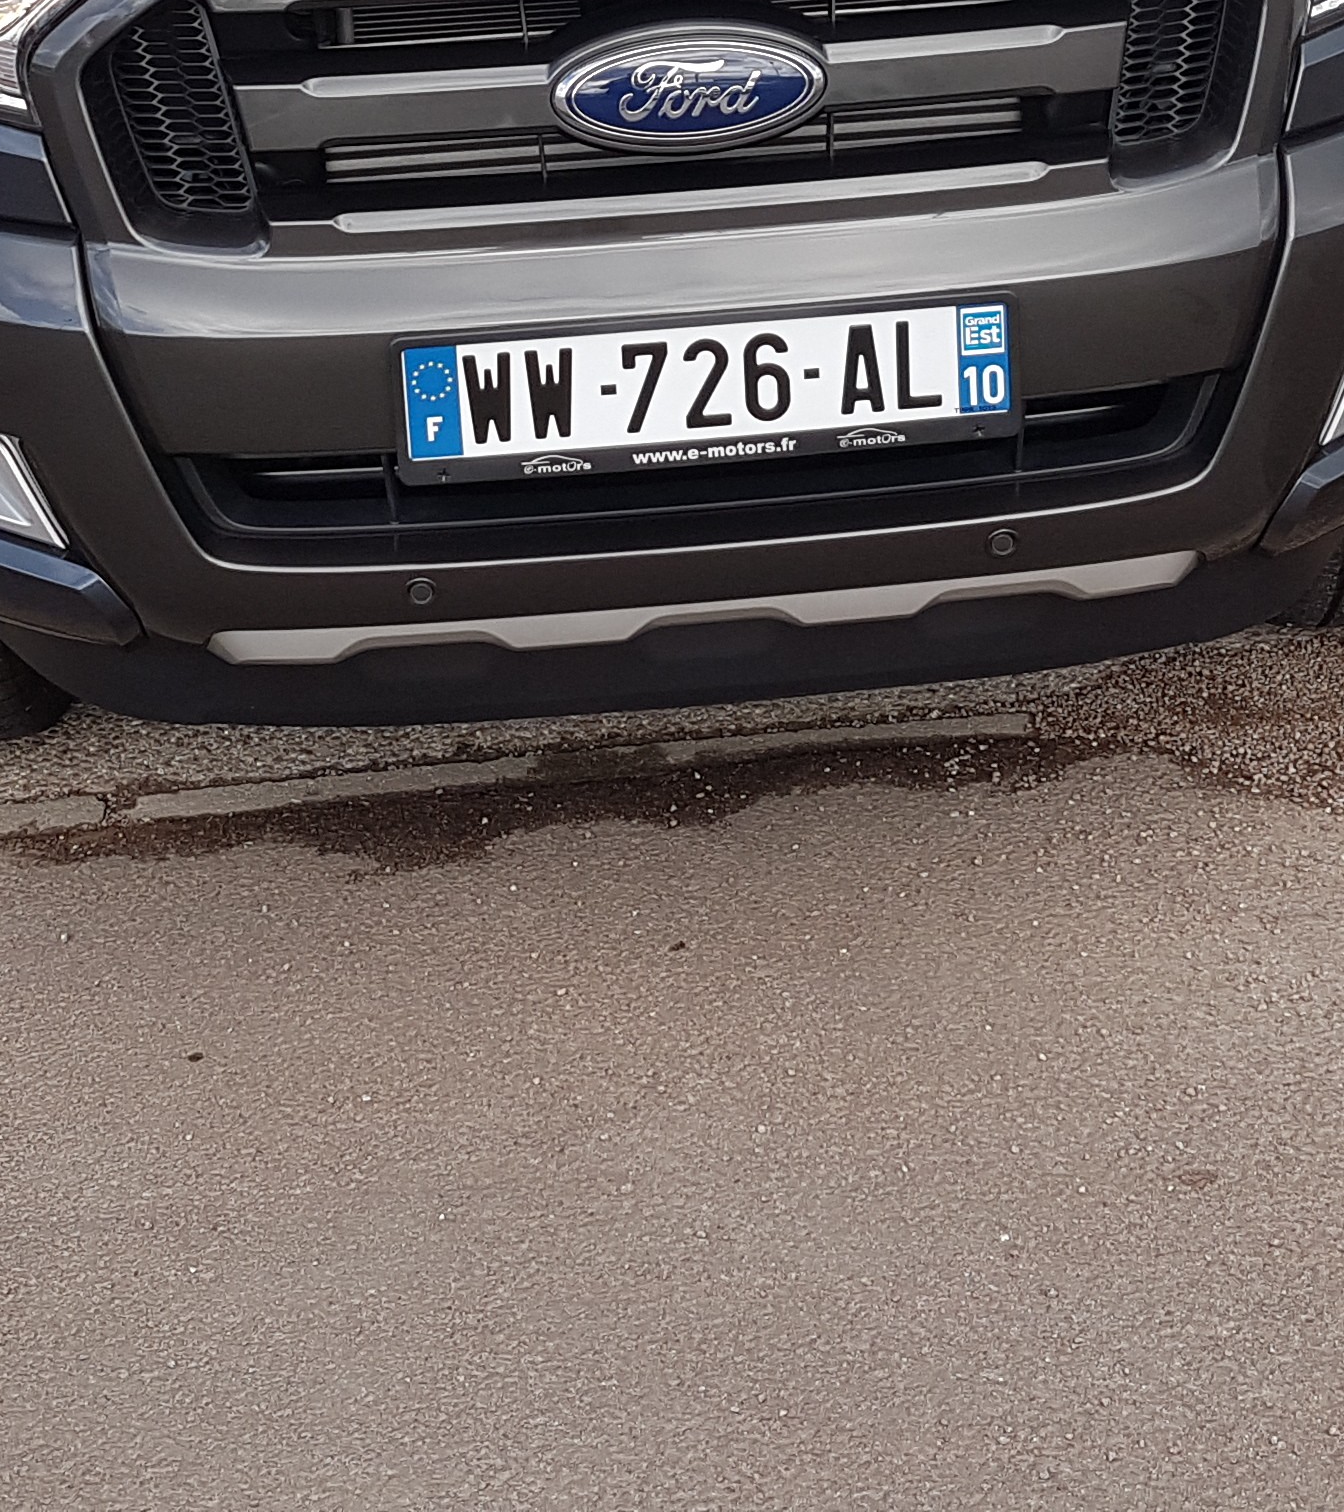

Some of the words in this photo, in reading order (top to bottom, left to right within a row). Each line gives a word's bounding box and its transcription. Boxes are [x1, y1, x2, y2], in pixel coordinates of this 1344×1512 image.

[619, 59, 762, 123] Ford
[965, 314, 1000, 326] Grand
[965, 325, 1001, 345] Est
[963, 364, 1005, 406] 10
[427, 416, 444, 442] F
[632, 437, 797, 465] www.e-motors.fr
